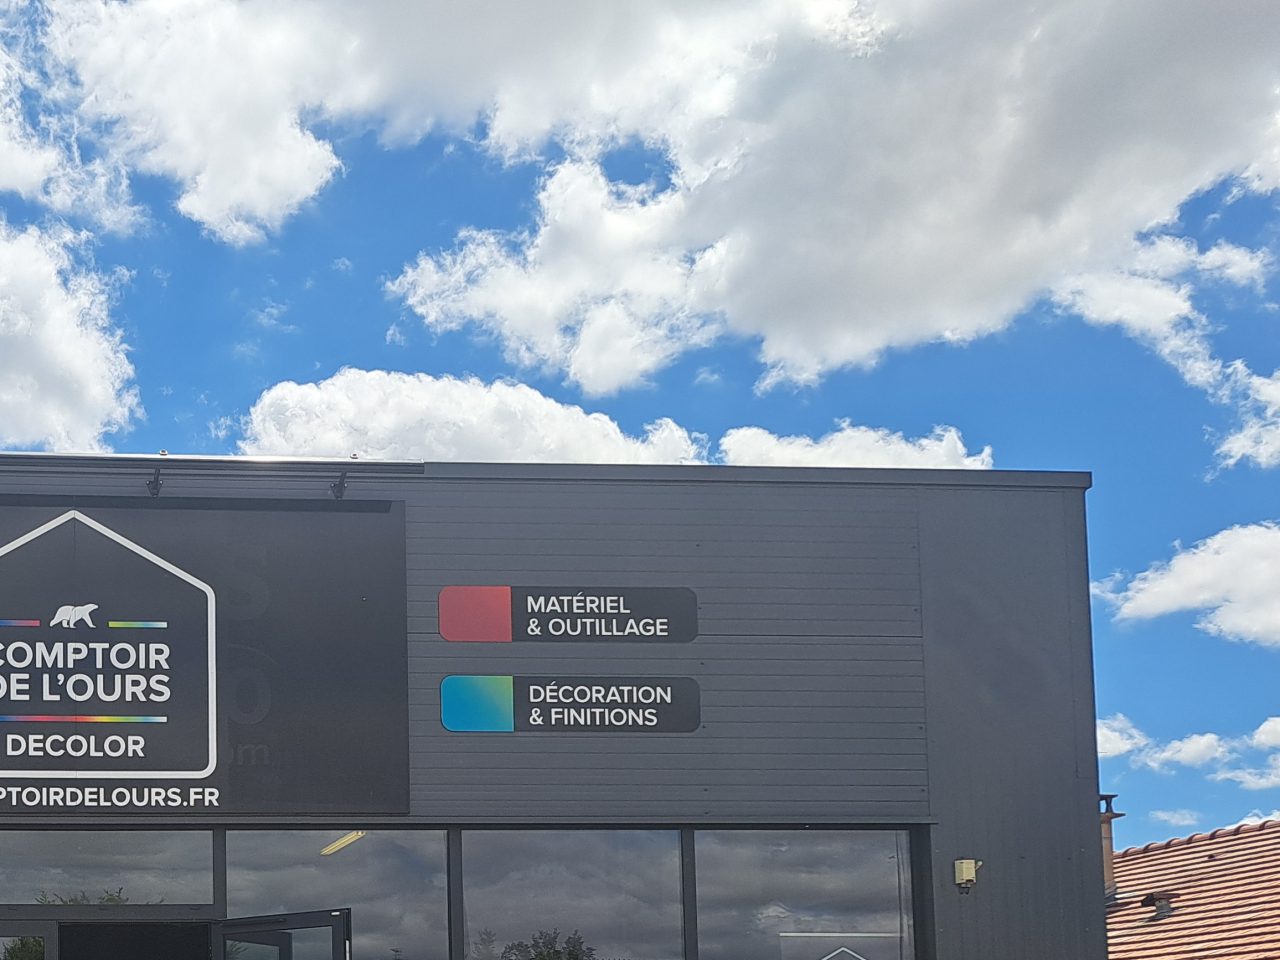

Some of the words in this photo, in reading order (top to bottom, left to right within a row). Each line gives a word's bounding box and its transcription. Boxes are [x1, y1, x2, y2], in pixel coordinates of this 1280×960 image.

[527, 592, 630, 614] MATÉRIEL
[527, 618, 542, 636] &
[548, 618, 669, 636] OUTILLAGE
[42, 673, 171, 703] L'OURS
[529, 681, 672, 704] DÉCORATION
[529, 707, 544, 726] &
[551, 708, 658, 727] FINITIONS
[6, 734, 145, 758] DECOLOR
